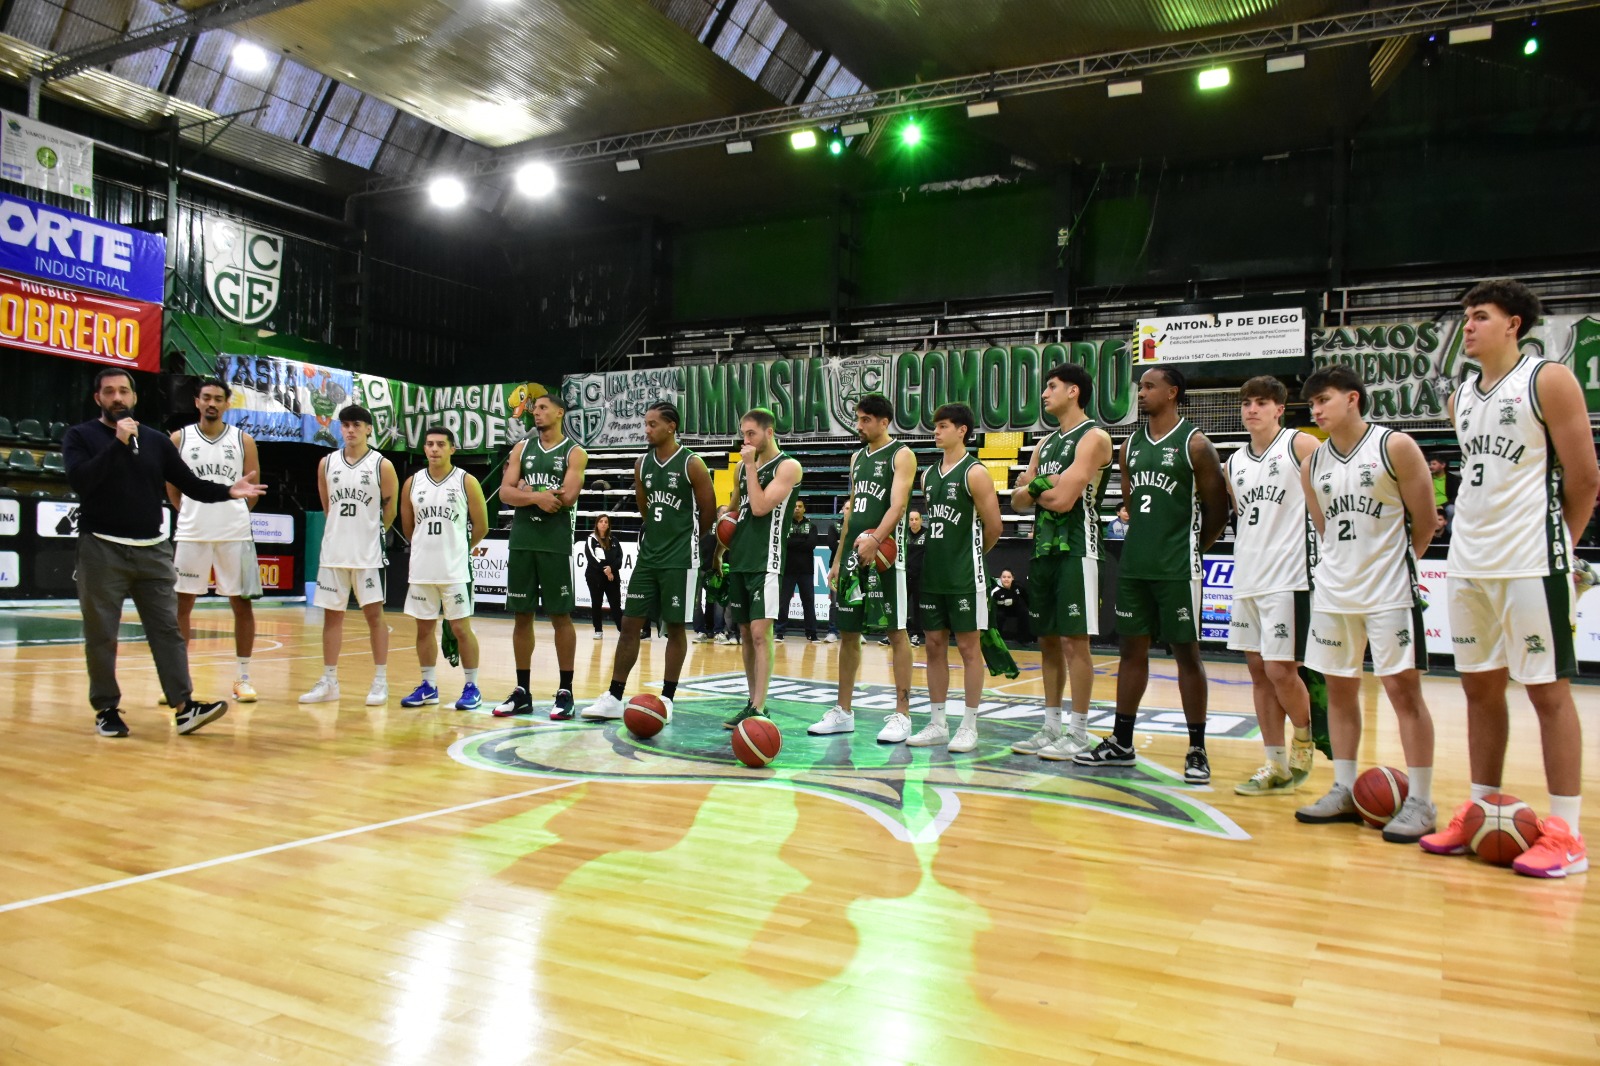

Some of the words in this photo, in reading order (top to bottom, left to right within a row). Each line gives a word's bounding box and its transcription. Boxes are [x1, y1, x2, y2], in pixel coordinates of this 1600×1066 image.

[0, 200, 132, 272] ORTE
[249, 235, 279, 271] C
[35, 257, 130, 291] INDUSTRIAL
[20, 280, 77, 302] MUEBLES
[214, 272, 240, 318] G
[0, 293, 140, 359] OBRERO
[1166, 320, 1221, 331] ANTONO
[1226, 319, 1233, 327] P
[1238, 317, 1254, 326] DE
[1258, 314, 1298, 325] DIEGO
[369, 380, 385, 400] C
[897, 339, 1129, 431] COMODORO
[402, 381, 430, 414] LA
[433, 384, 505, 417] MAGIA
[236, 415, 303, 438] Argentina
[1460, 434, 1526, 469] NASIA
[190, 464, 237, 482] MNASIA
[1470, 463, 1484, 486] 3
[340, 503, 357, 517] 20
[647, 490, 682, 511] NASIA
[853, 497, 867, 513] 30
[1140, 494, 1152, 513] 2
[1326, 494, 1383, 520] MNSIA
[416, 505, 459, 525] GIMNASIA
[654, 507, 662, 521] 5
[928, 504, 962, 526] NASIA
[427, 521, 442, 535] 10
[930, 522, 944, 538] 12
[1210, 629, 1224, 637] 297
